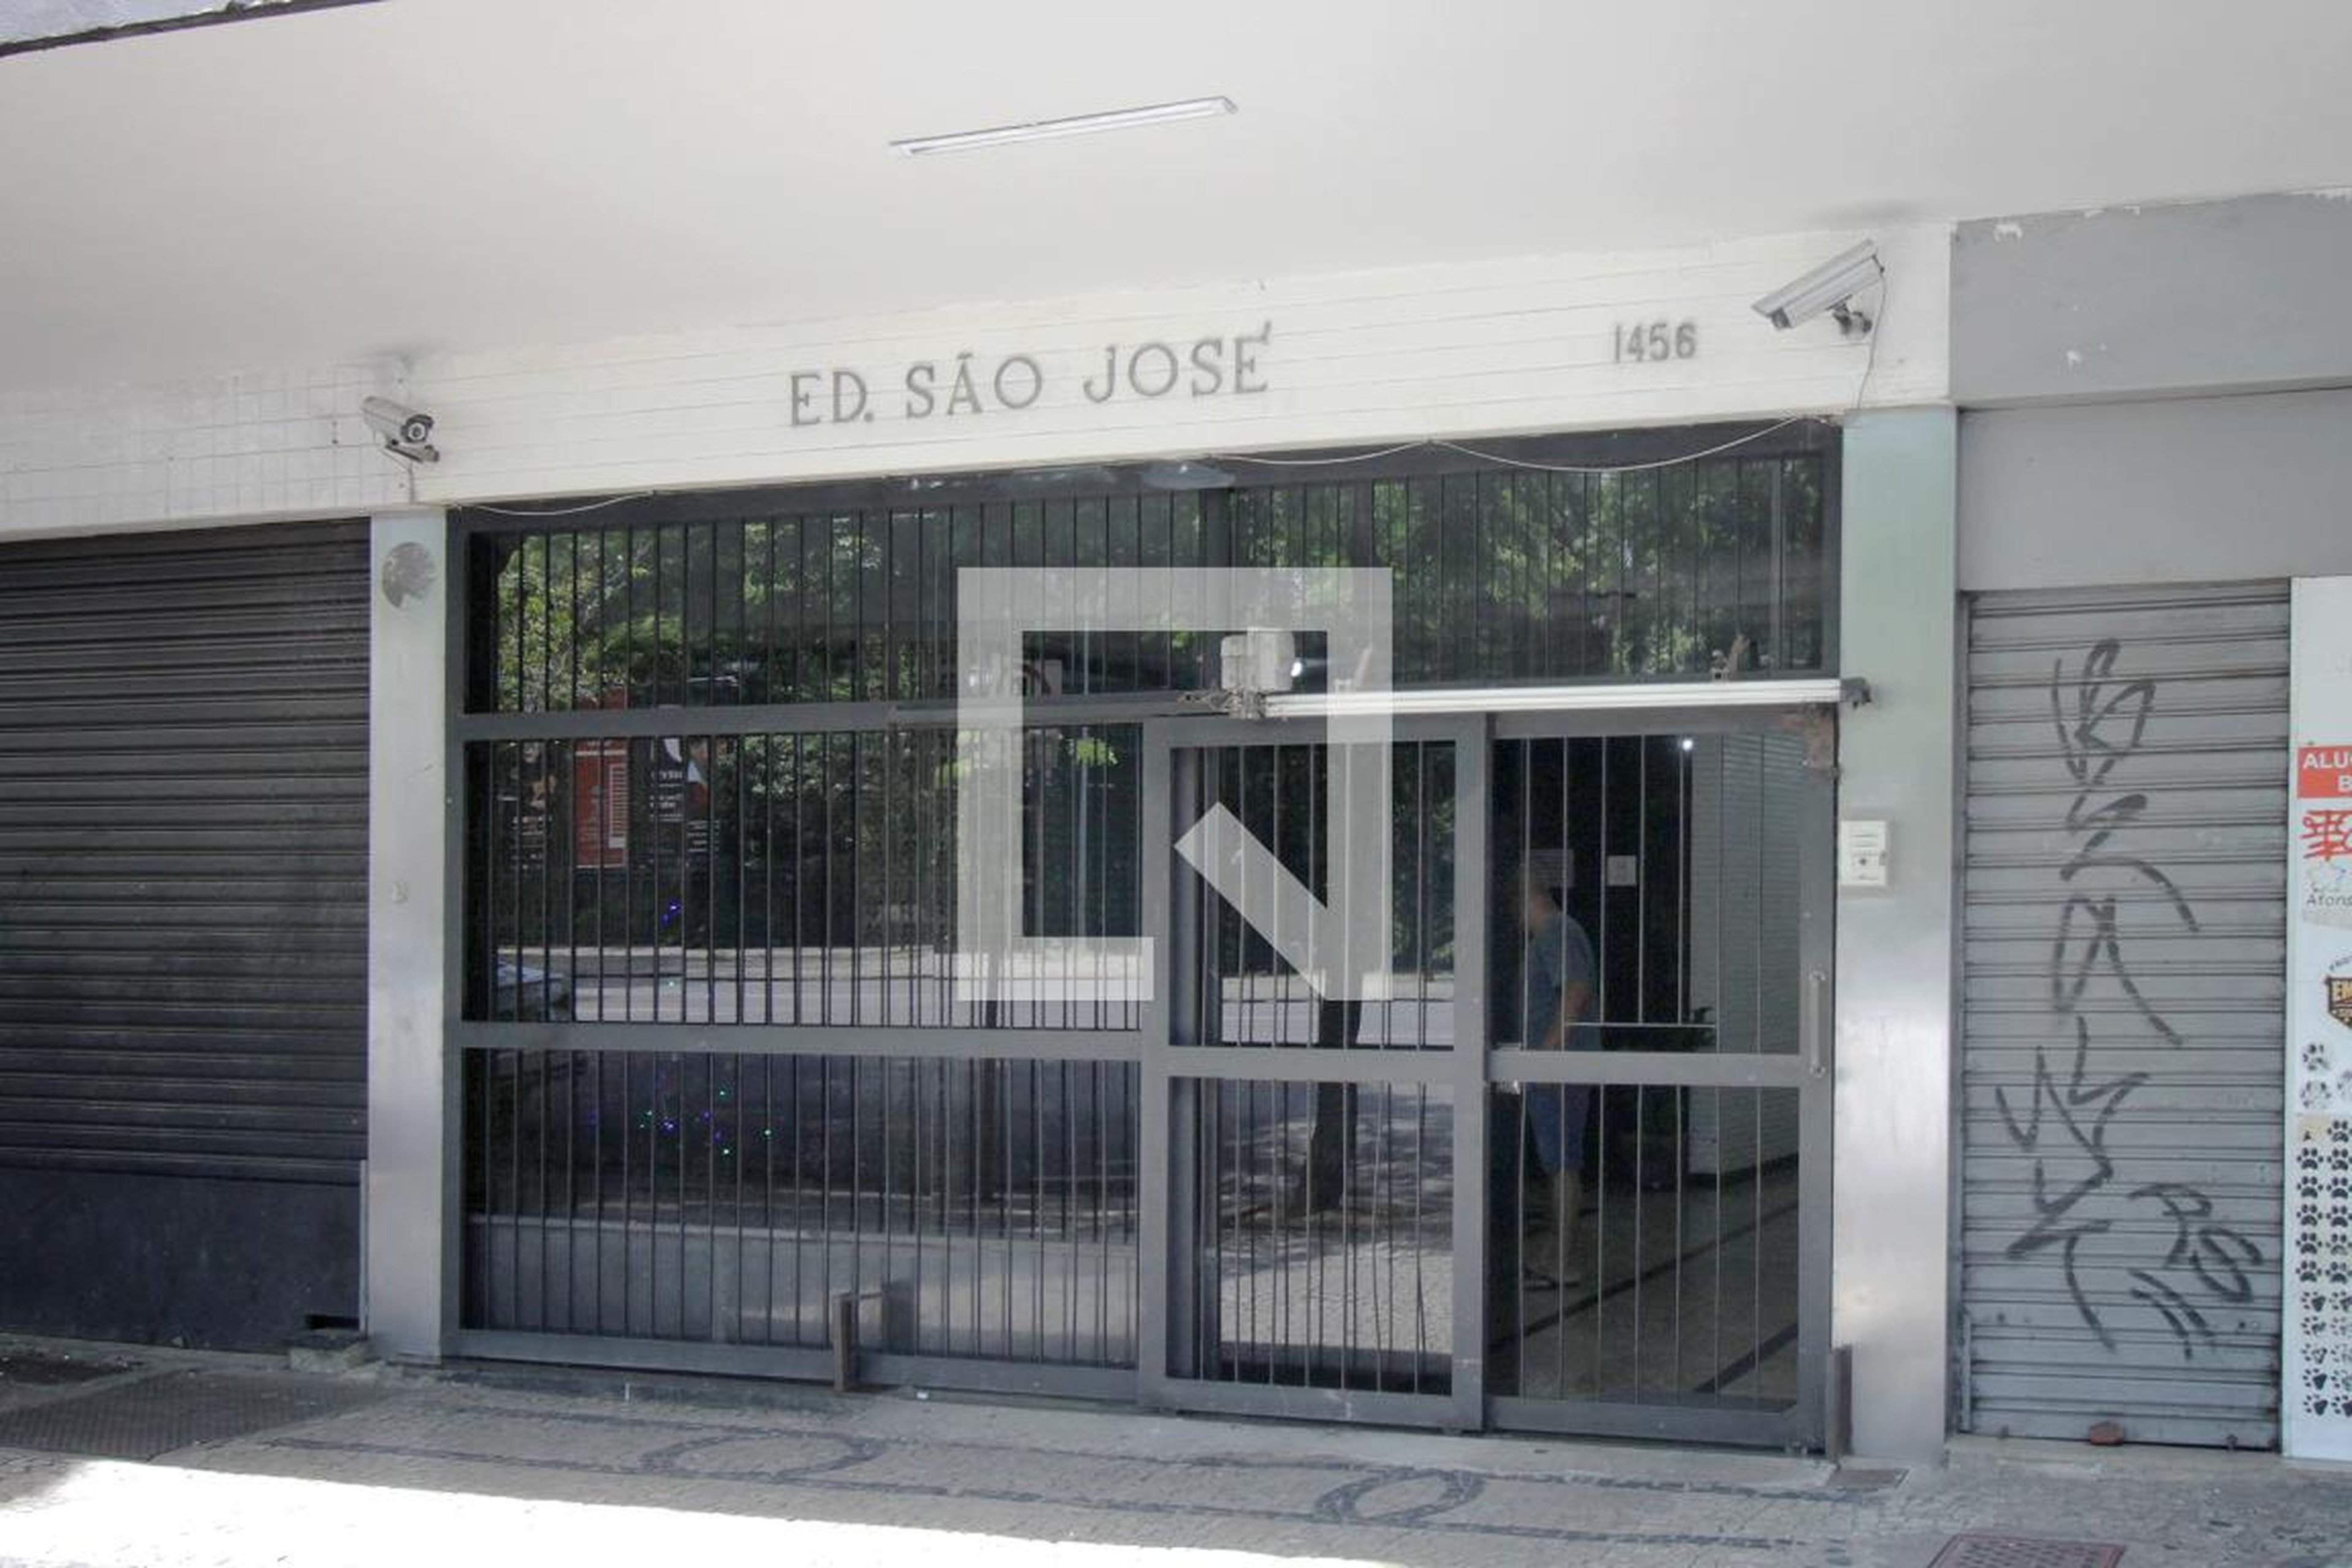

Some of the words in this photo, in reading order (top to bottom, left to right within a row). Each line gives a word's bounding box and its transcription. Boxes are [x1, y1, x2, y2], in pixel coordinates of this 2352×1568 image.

[1613, 322, 1697, 363] 1456
[790, 370, 874, 427] ED.
[905, 352, 1042, 419] SÃO
[1083, 320, 1272, 404] JOSÉ
[2303, 751, 2352, 769] ALU
